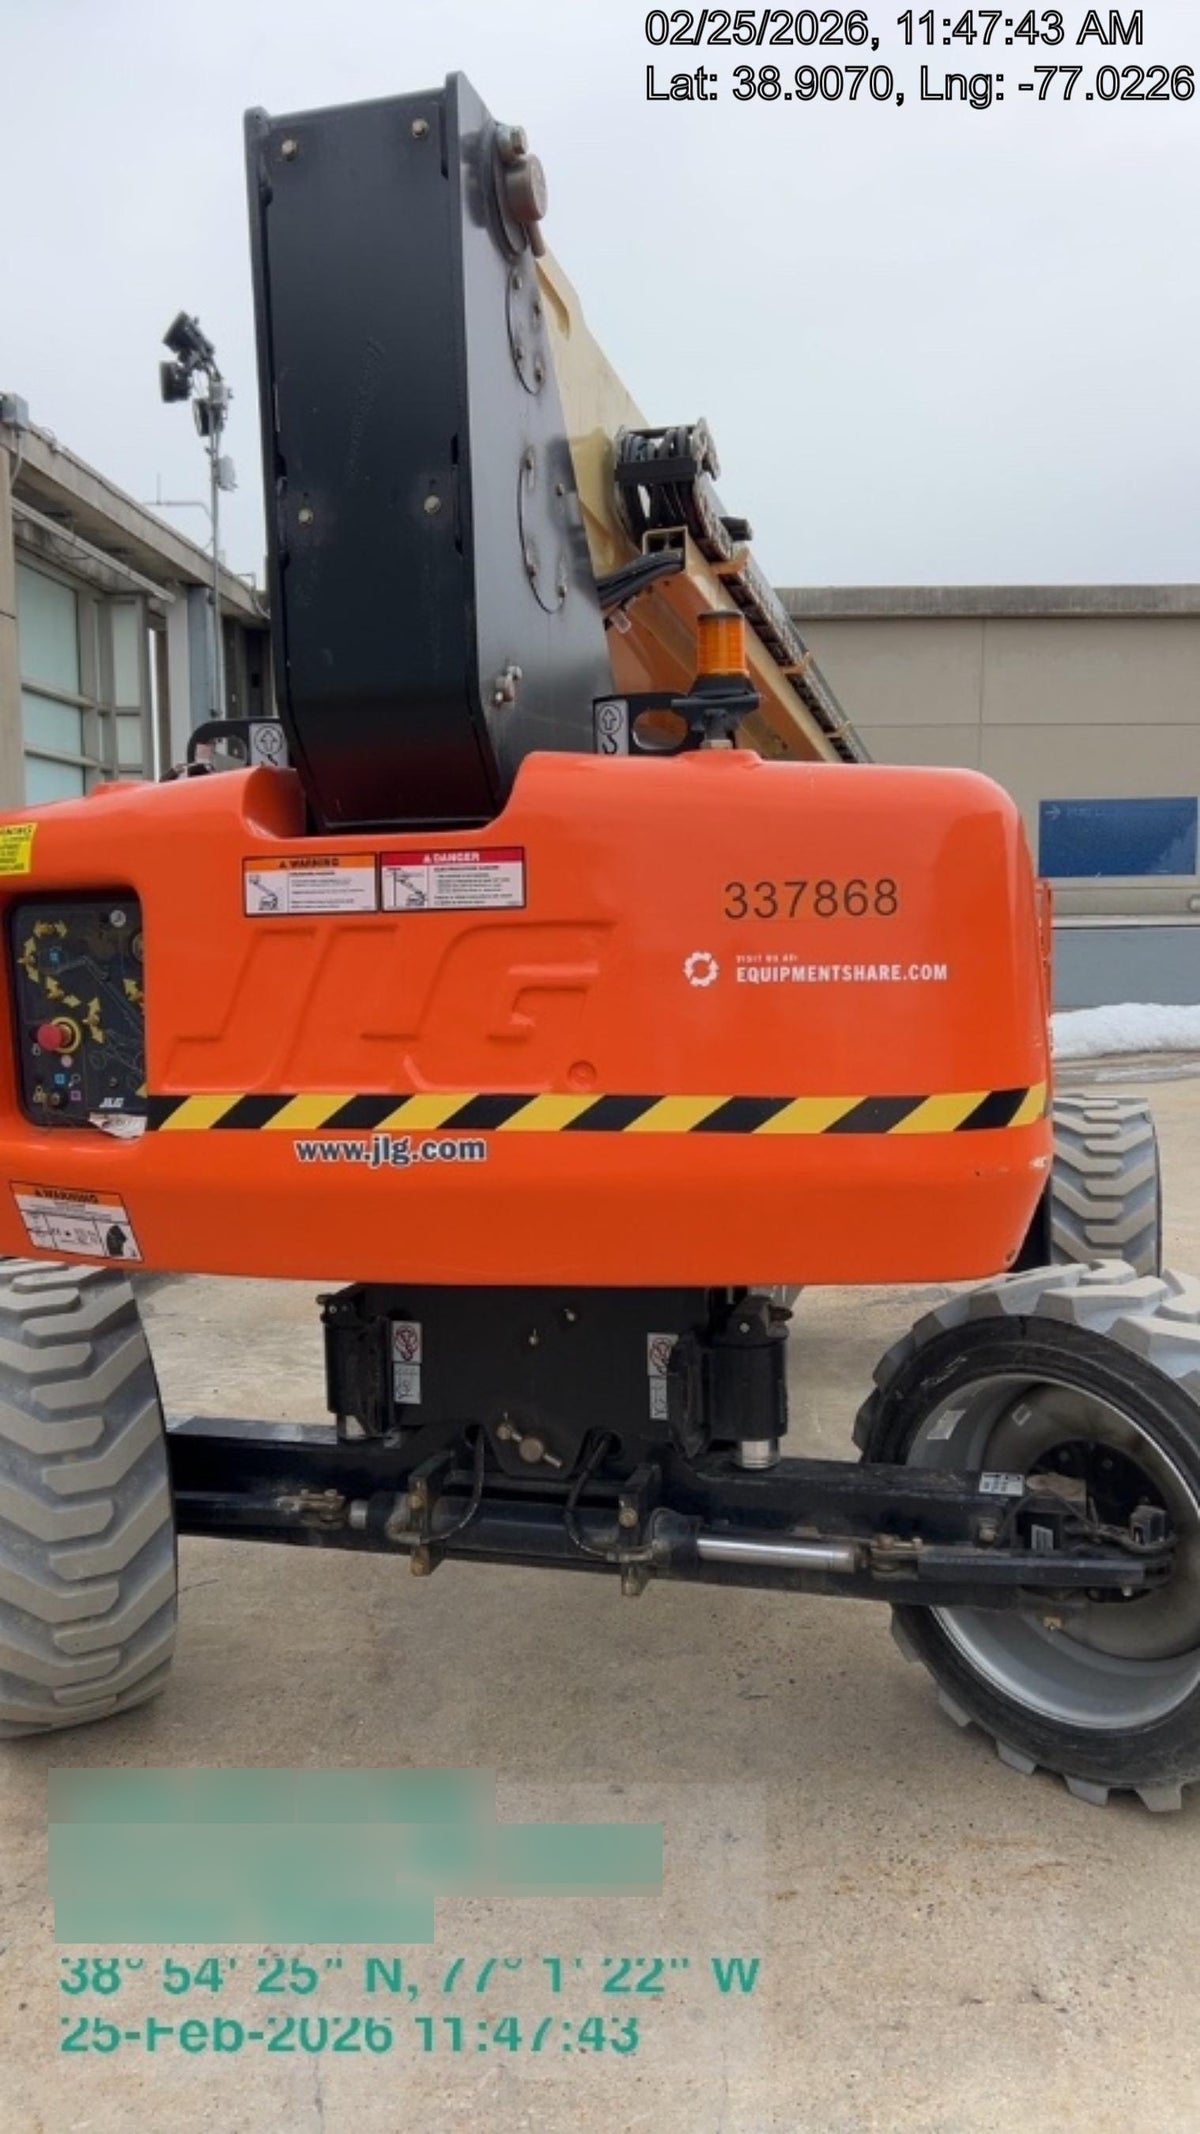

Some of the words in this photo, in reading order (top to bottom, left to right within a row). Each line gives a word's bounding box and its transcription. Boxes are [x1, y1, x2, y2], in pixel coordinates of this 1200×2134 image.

[433, 852, 480, 864] DANGER
[723, 878, 898, 919] 337868
[737, 965, 947, 984] EQUIPMENTSHARE.COM
[294, 1133, 487, 1168] www.jlg.com
